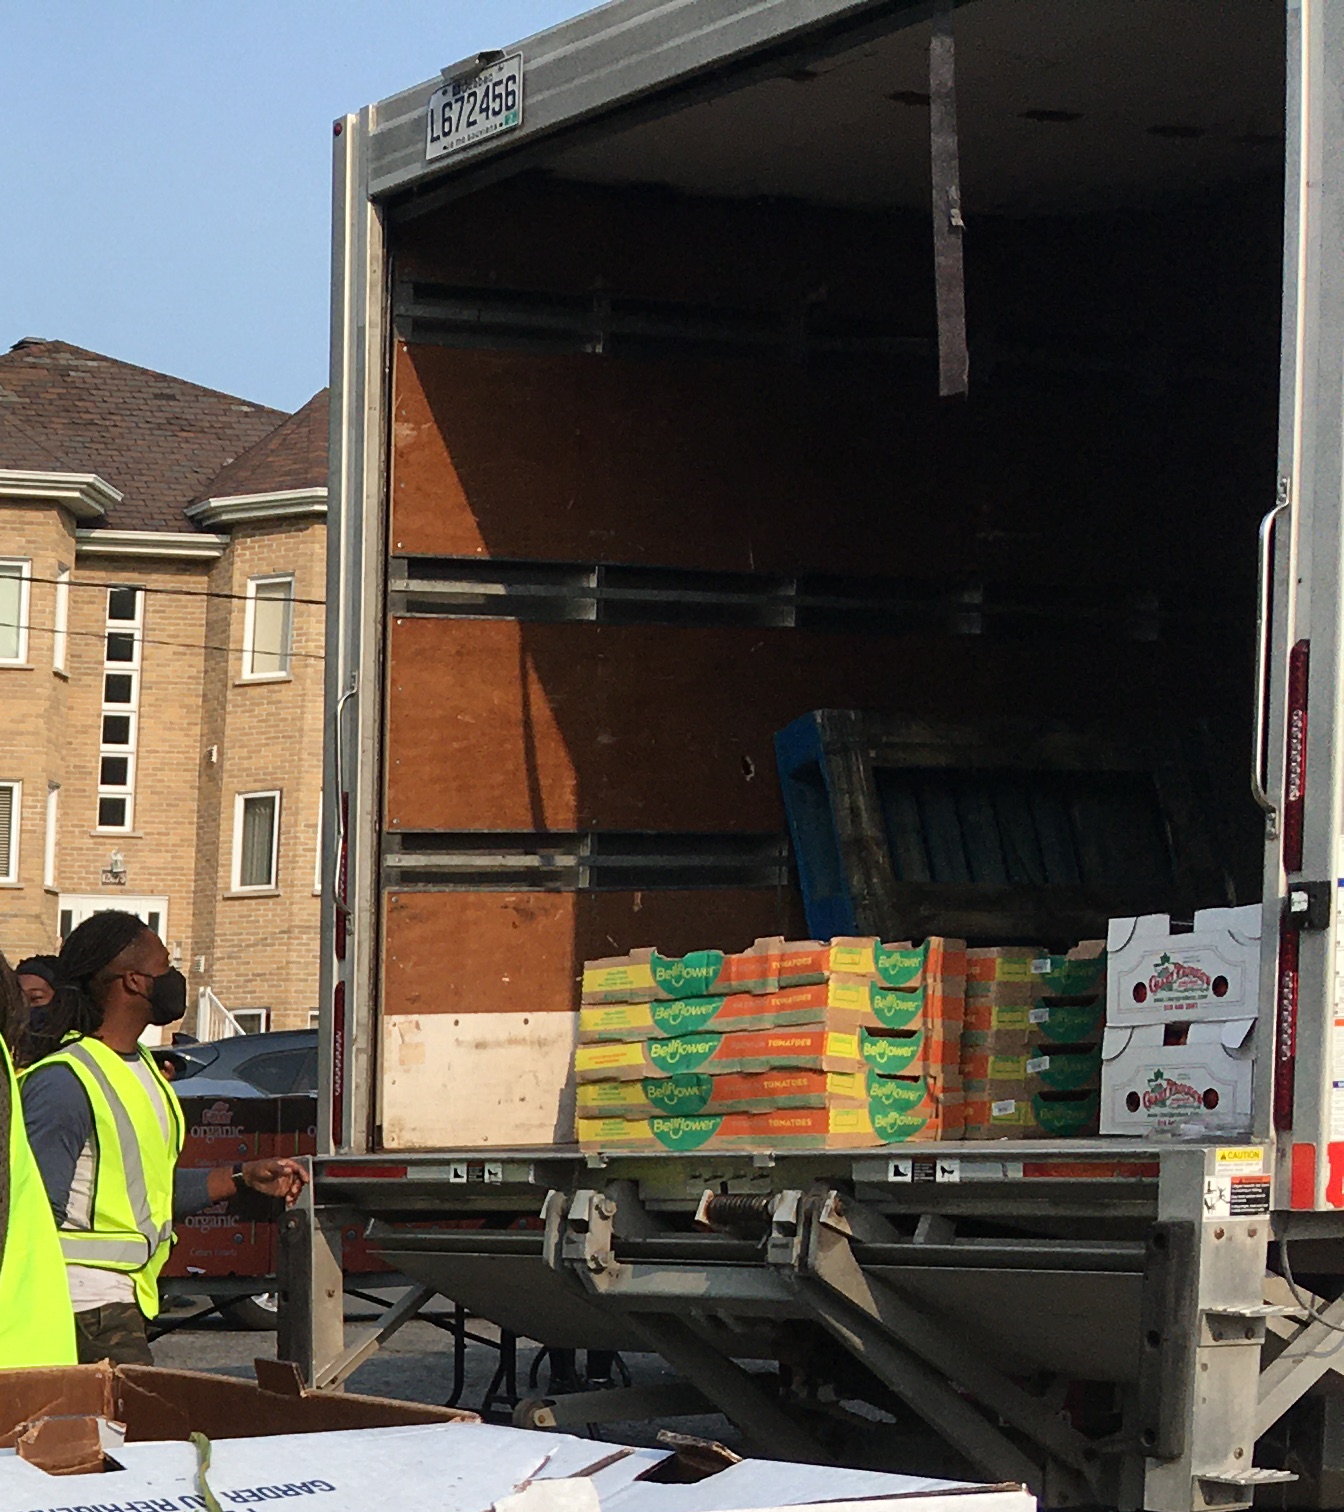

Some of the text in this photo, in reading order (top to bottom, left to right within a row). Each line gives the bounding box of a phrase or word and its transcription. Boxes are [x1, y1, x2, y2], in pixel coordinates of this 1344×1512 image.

[430, 74, 517, 143] L672456
[651, 1037, 713, 1064] Bellflower
[191, 1125, 244, 1143] organic
[653, 1115, 716, 1139] Bellflower
[185, 1214, 239, 1233] organic
[220, 1479, 337, 1504] GARDER
